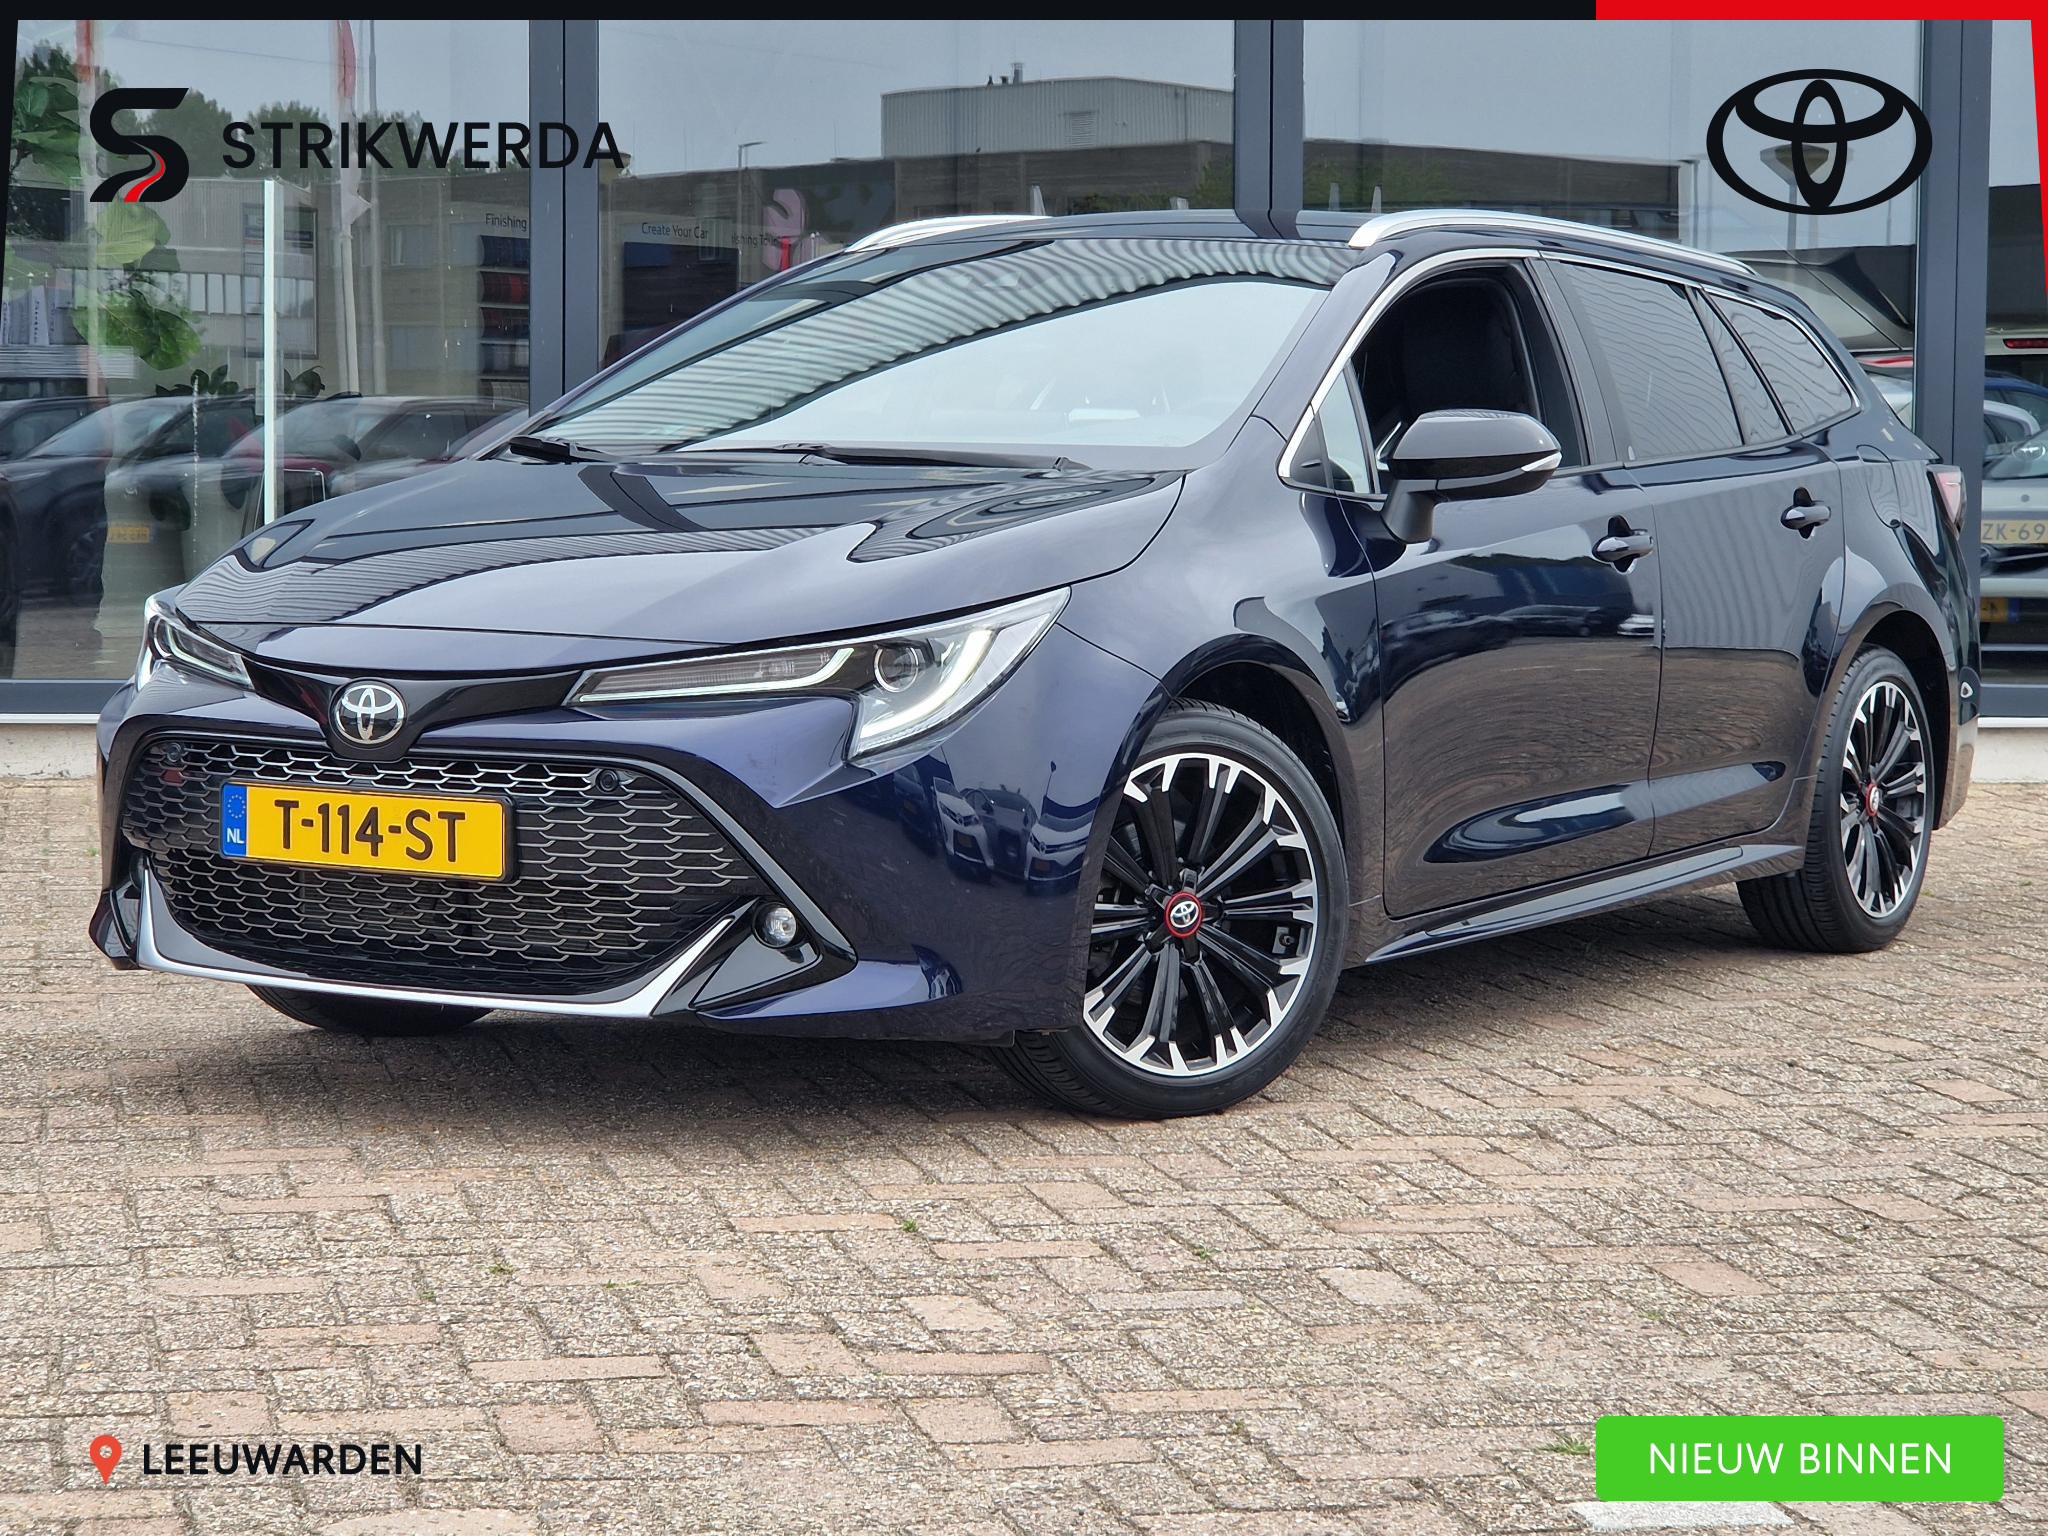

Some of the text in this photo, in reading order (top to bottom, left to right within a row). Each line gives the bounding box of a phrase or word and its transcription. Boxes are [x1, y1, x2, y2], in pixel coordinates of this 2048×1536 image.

[485, 212, 528, 232] Finishing
[641, 222, 708, 240] Create Your Car
[226, 827, 245, 845] NL
[274, 798, 466, 863] T-114-ST
